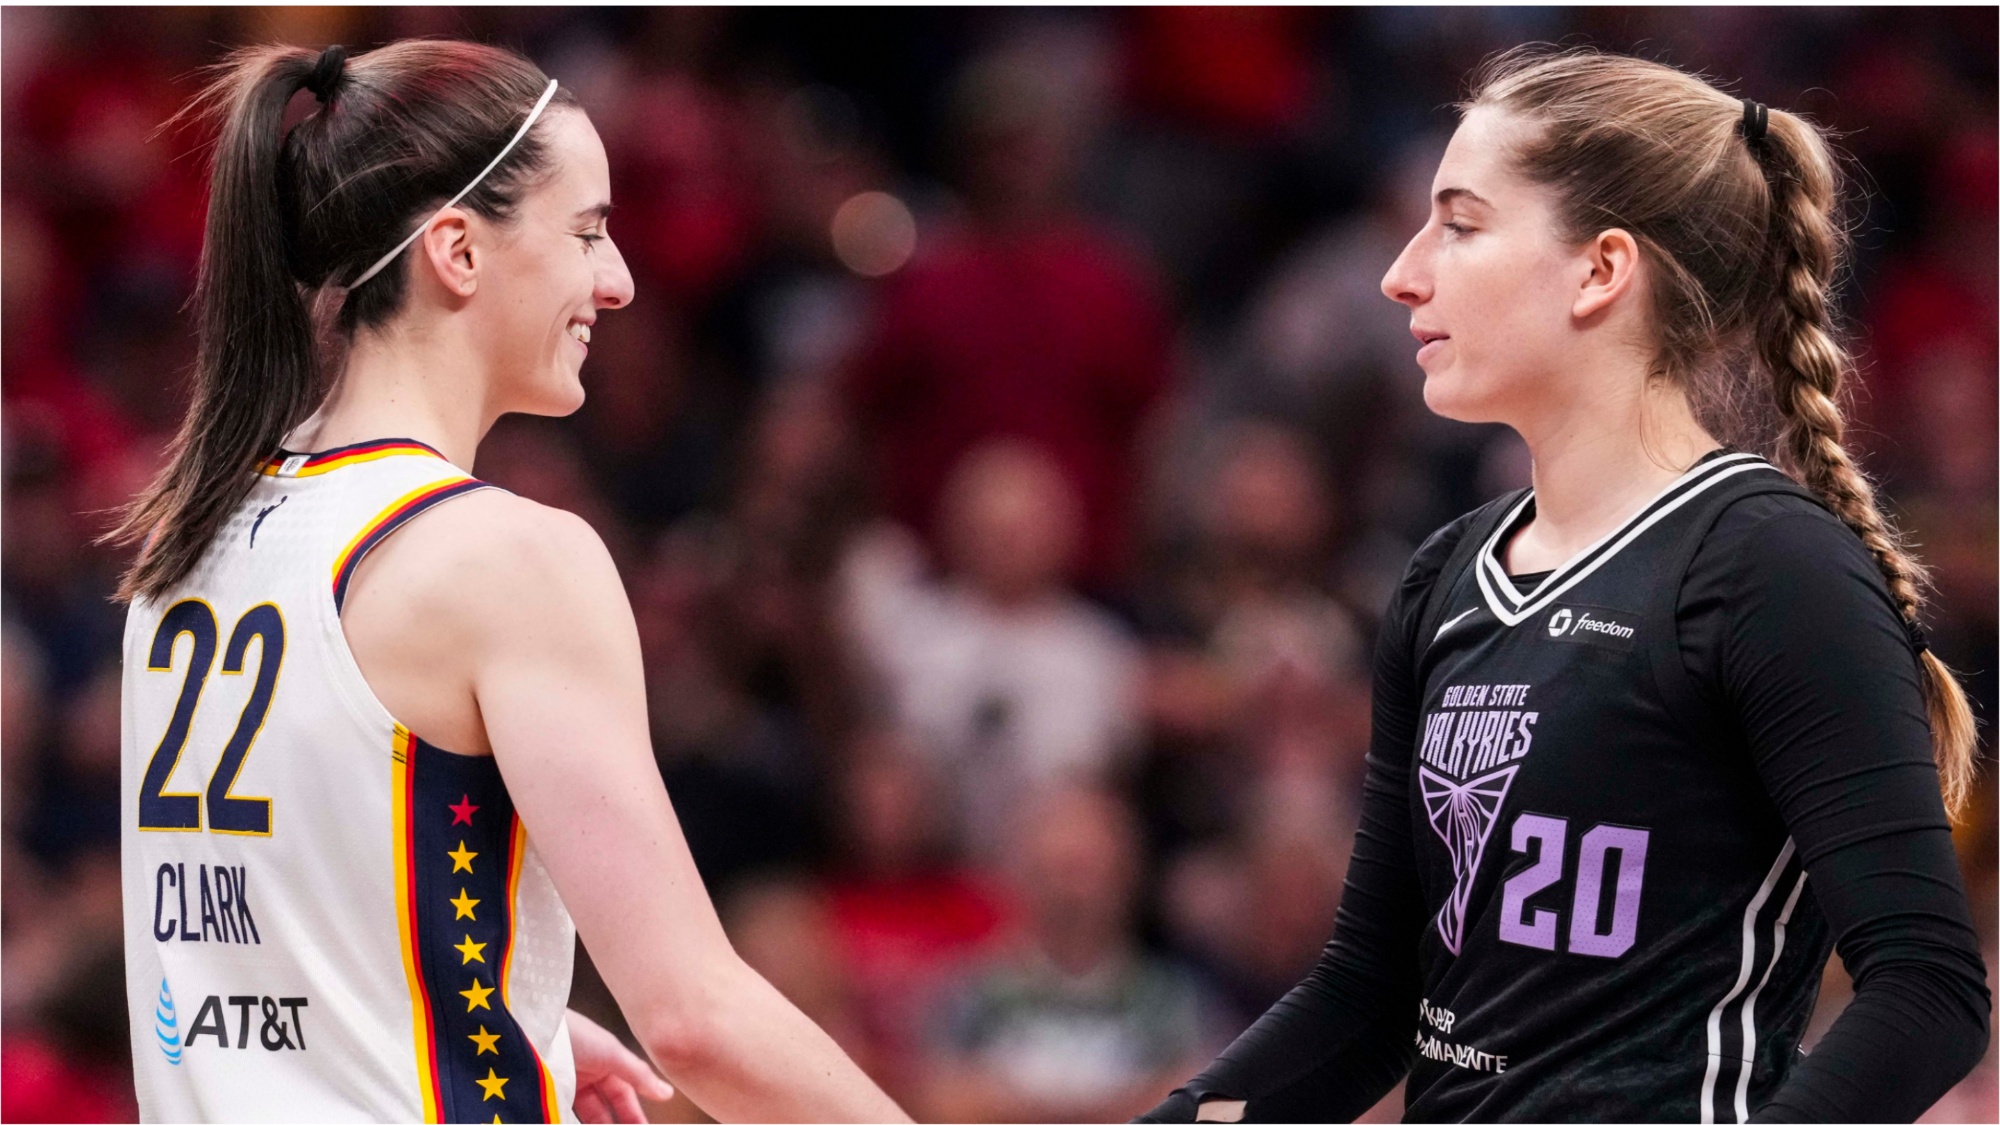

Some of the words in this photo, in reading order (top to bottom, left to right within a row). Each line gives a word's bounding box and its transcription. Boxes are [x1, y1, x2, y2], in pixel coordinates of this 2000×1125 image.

[1570, 612, 1635, 639] freedom
[138, 597, 287, 837] 22
[1441, 684, 1491, 708] GOLDEN
[1487, 684, 1531, 707] STATE
[1419, 710, 1539, 780] VALKYRIES
[153, 862, 261, 945] CLARK
[1500, 812, 1650, 959] 20
[184, 995, 308, 1052] AT&T
